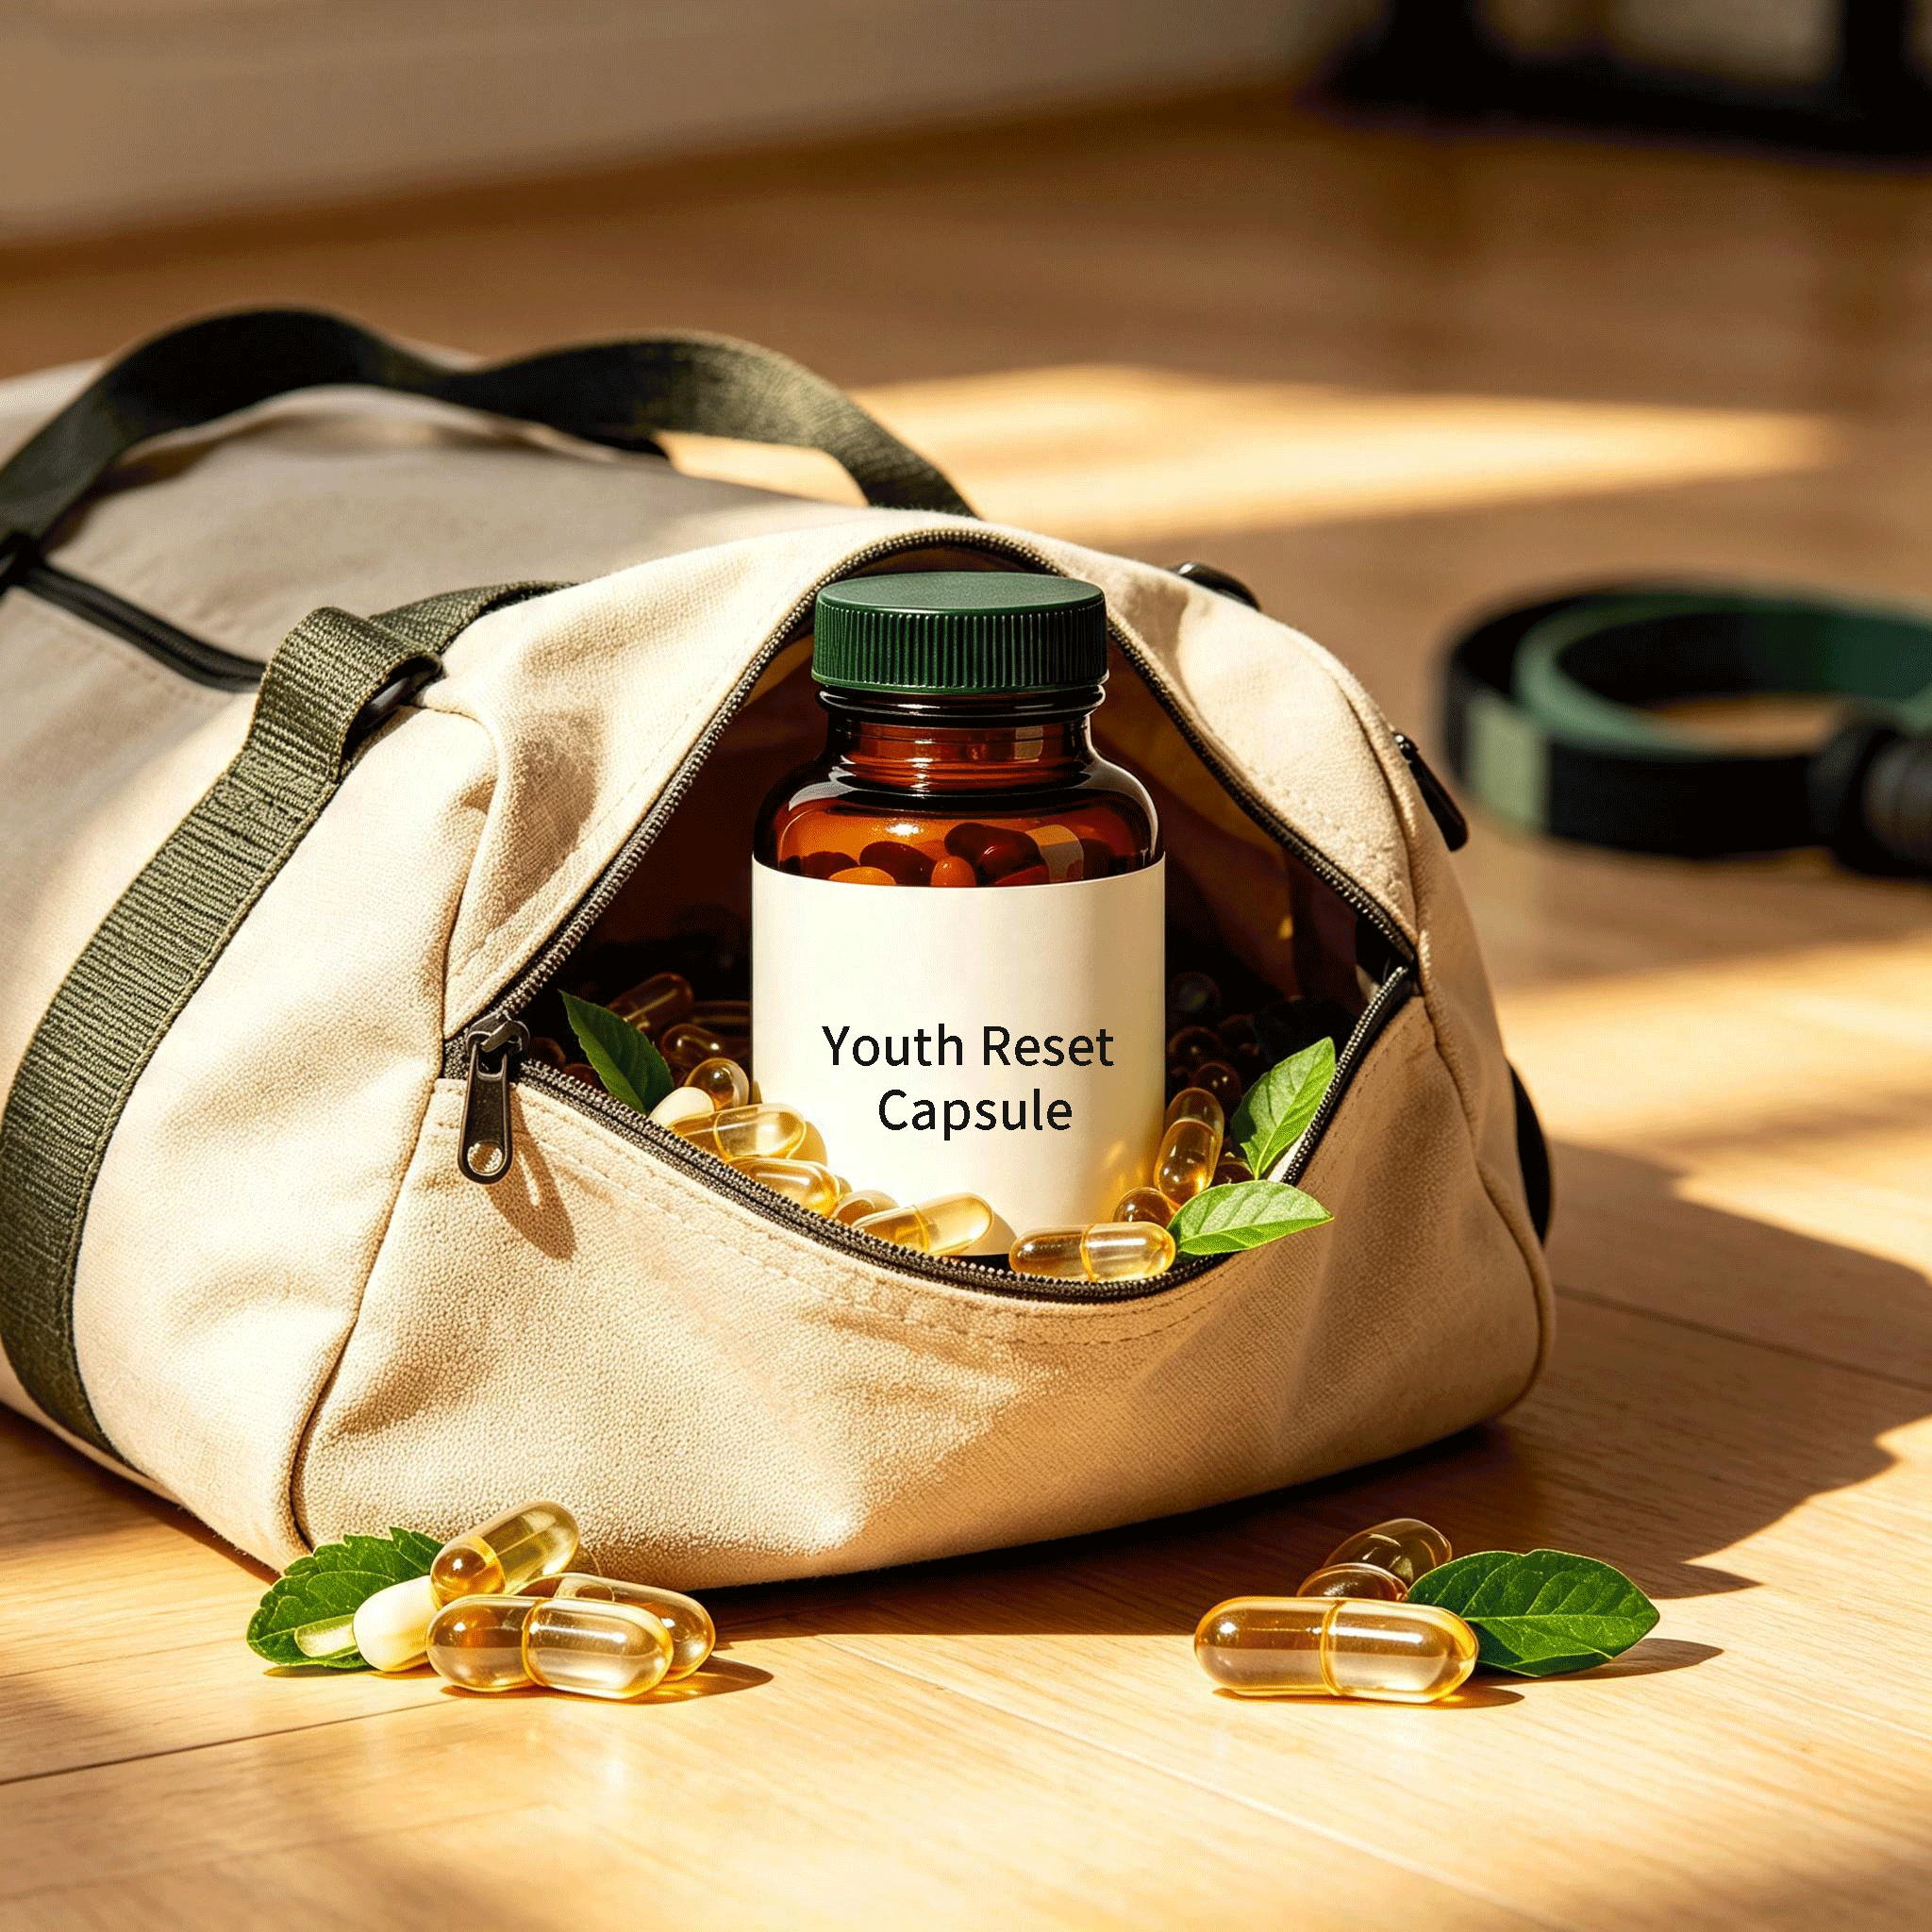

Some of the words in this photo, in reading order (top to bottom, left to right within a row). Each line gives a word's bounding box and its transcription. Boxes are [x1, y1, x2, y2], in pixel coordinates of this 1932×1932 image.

[822, 1024, 962, 1066] Youth
[983, 1025, 1114, 1066] Reset
[879, 1089, 1073, 1141] Capsule
